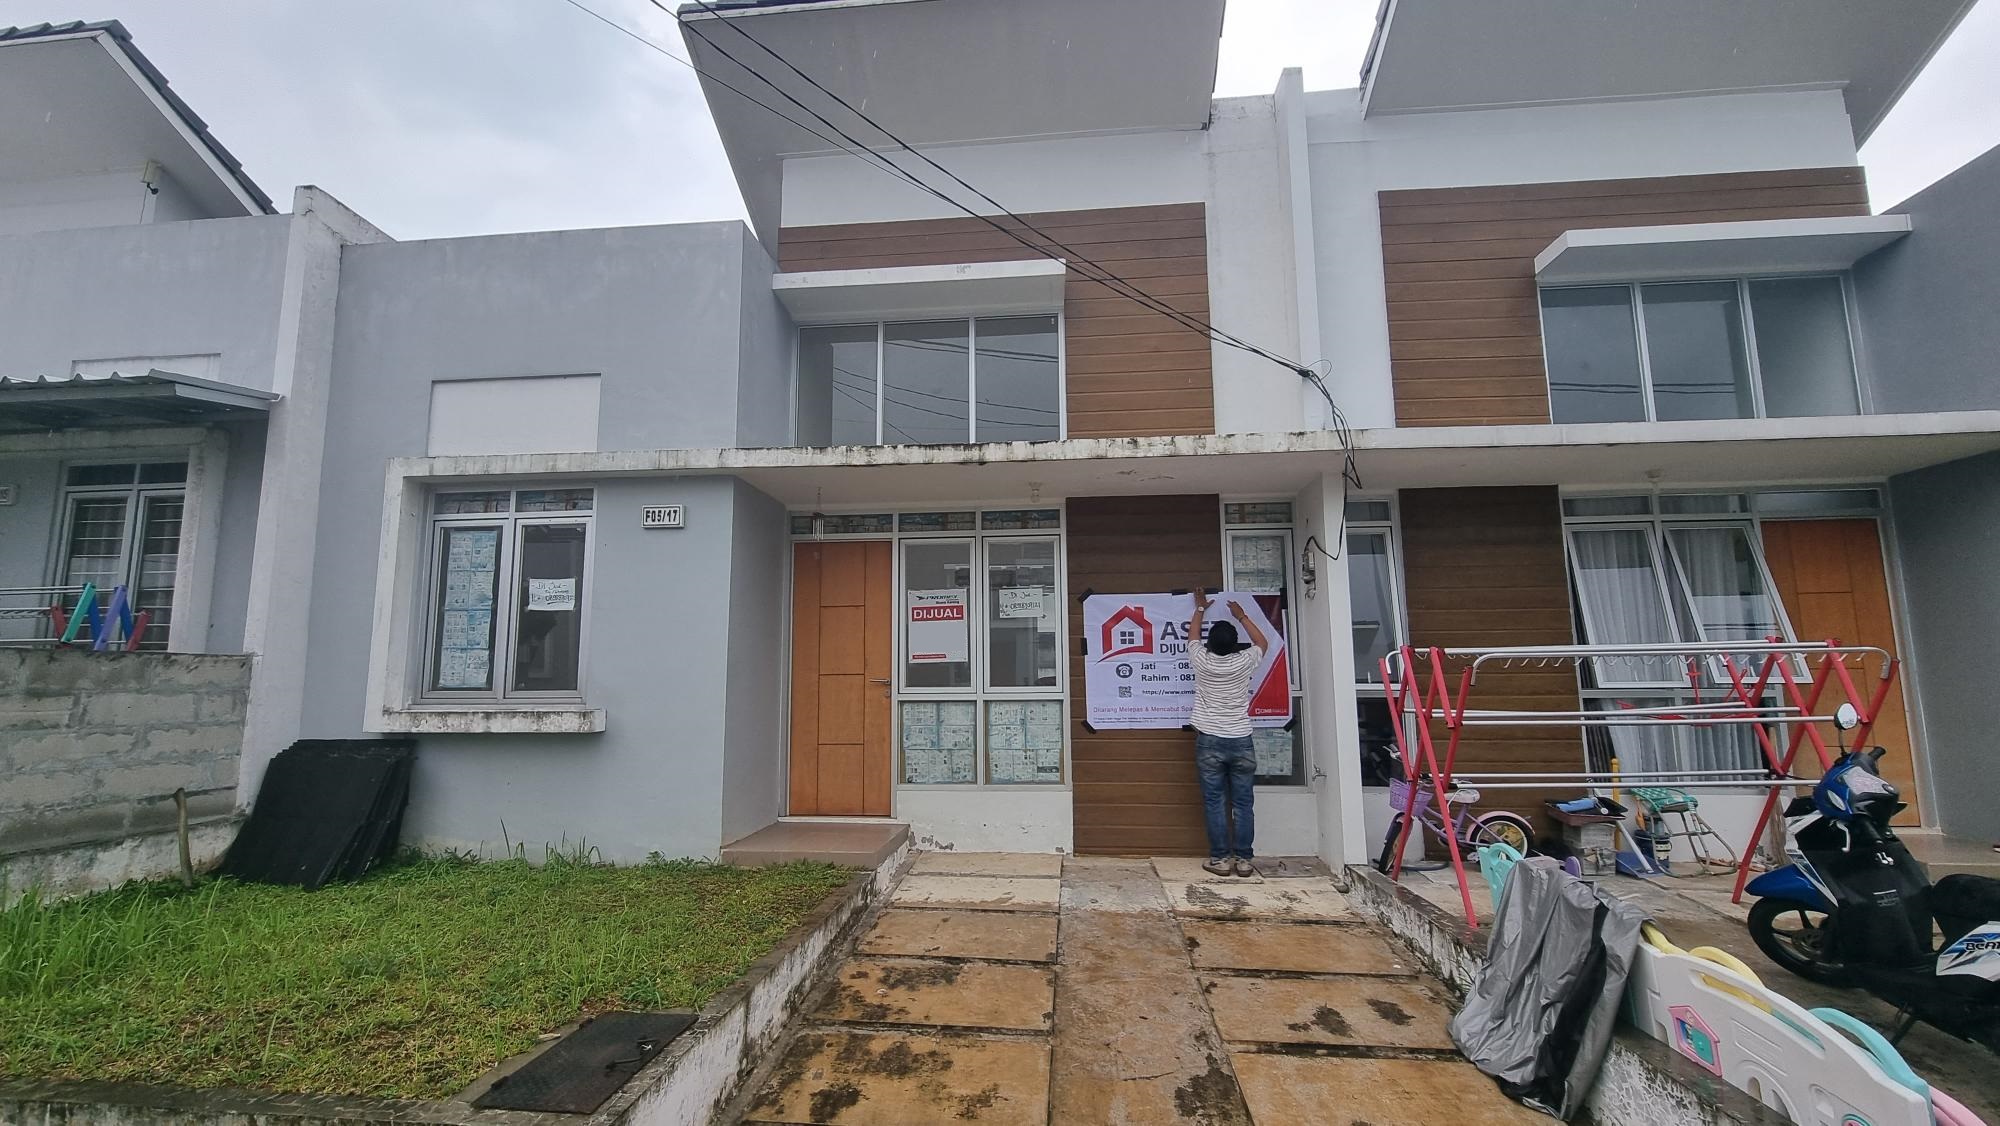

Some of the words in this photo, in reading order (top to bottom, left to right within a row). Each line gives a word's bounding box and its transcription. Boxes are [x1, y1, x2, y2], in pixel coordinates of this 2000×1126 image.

[645, 509, 677, 523] F05/17
[913, 608, 962, 619] DIJUAL
[1160, 643, 1190, 656] DIJU
[1140, 662, 1156, 670] Jati
[1141, 674, 1170, 682] Rahim
